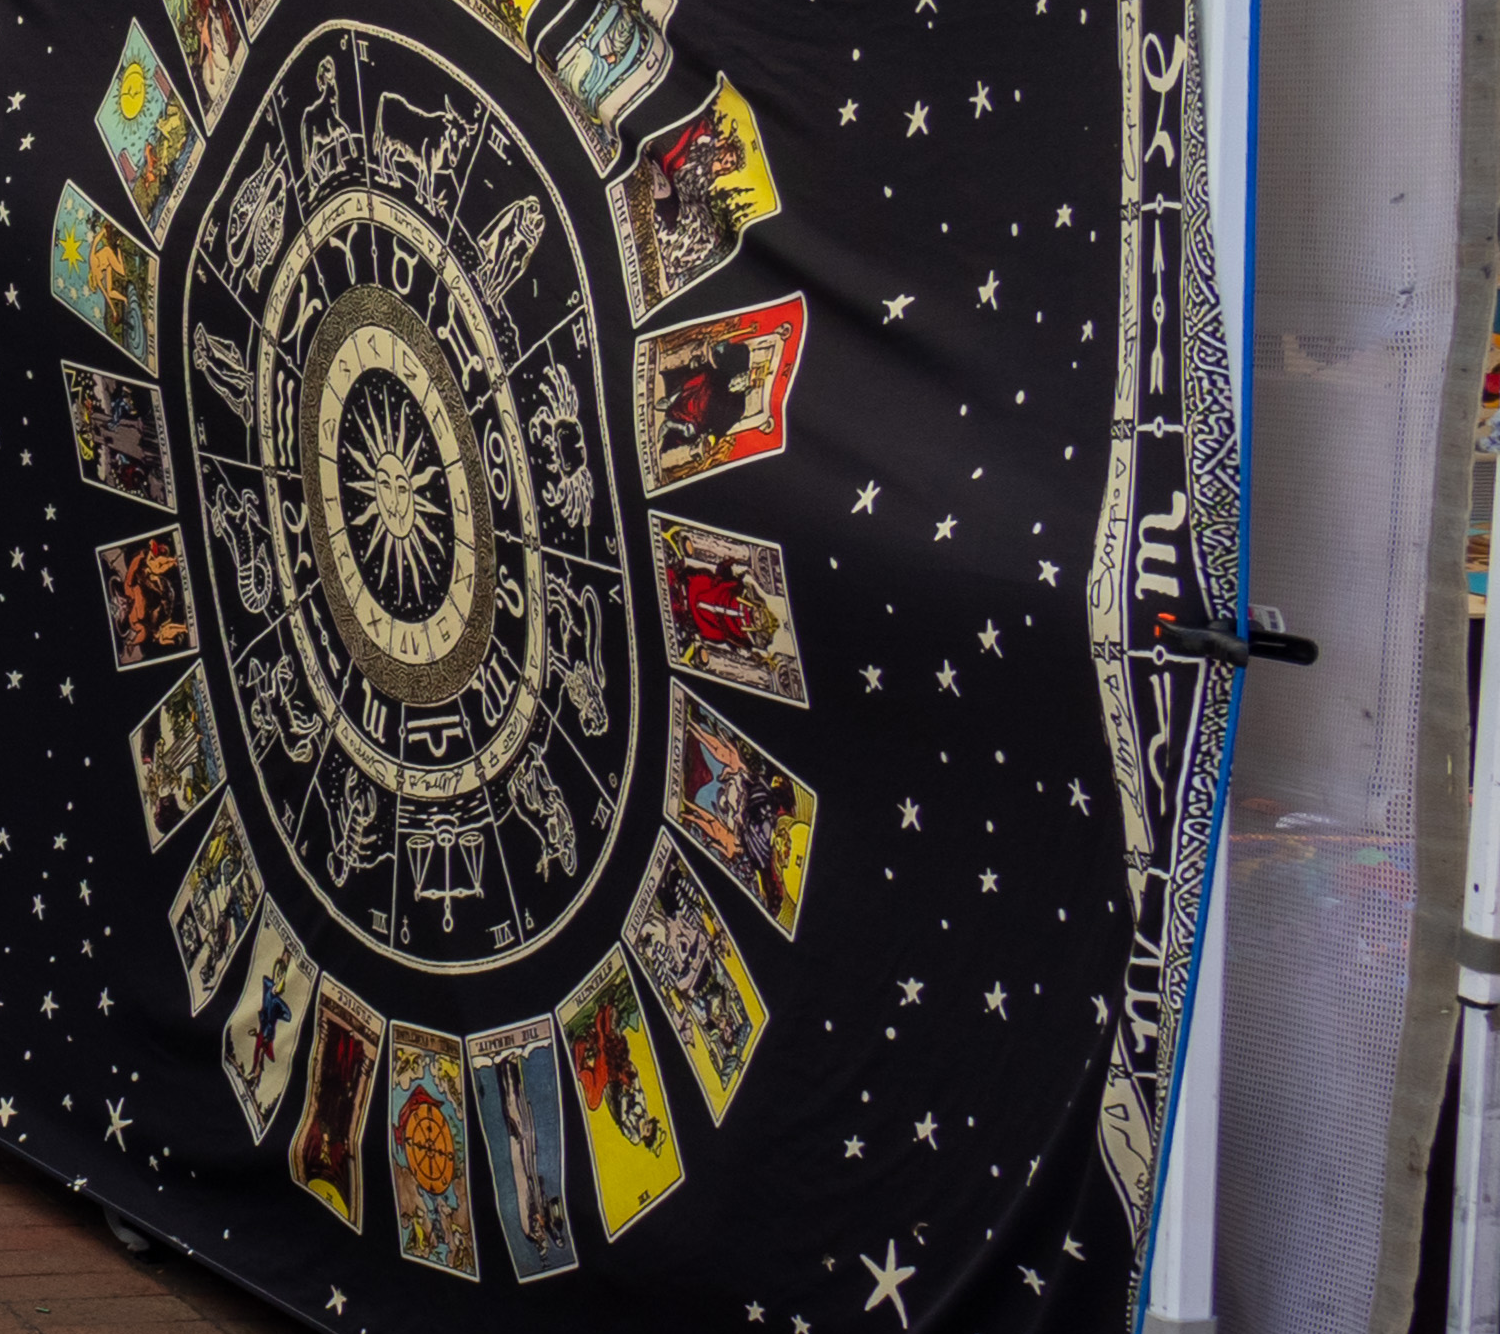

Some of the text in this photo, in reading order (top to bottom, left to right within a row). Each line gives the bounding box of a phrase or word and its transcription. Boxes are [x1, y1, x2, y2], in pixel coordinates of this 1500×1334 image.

[612, 188, 629, 228] THE
[634, 344, 648, 382] THE
[673, 694, 682, 729] THE
[653, 841, 670, 872] THE
